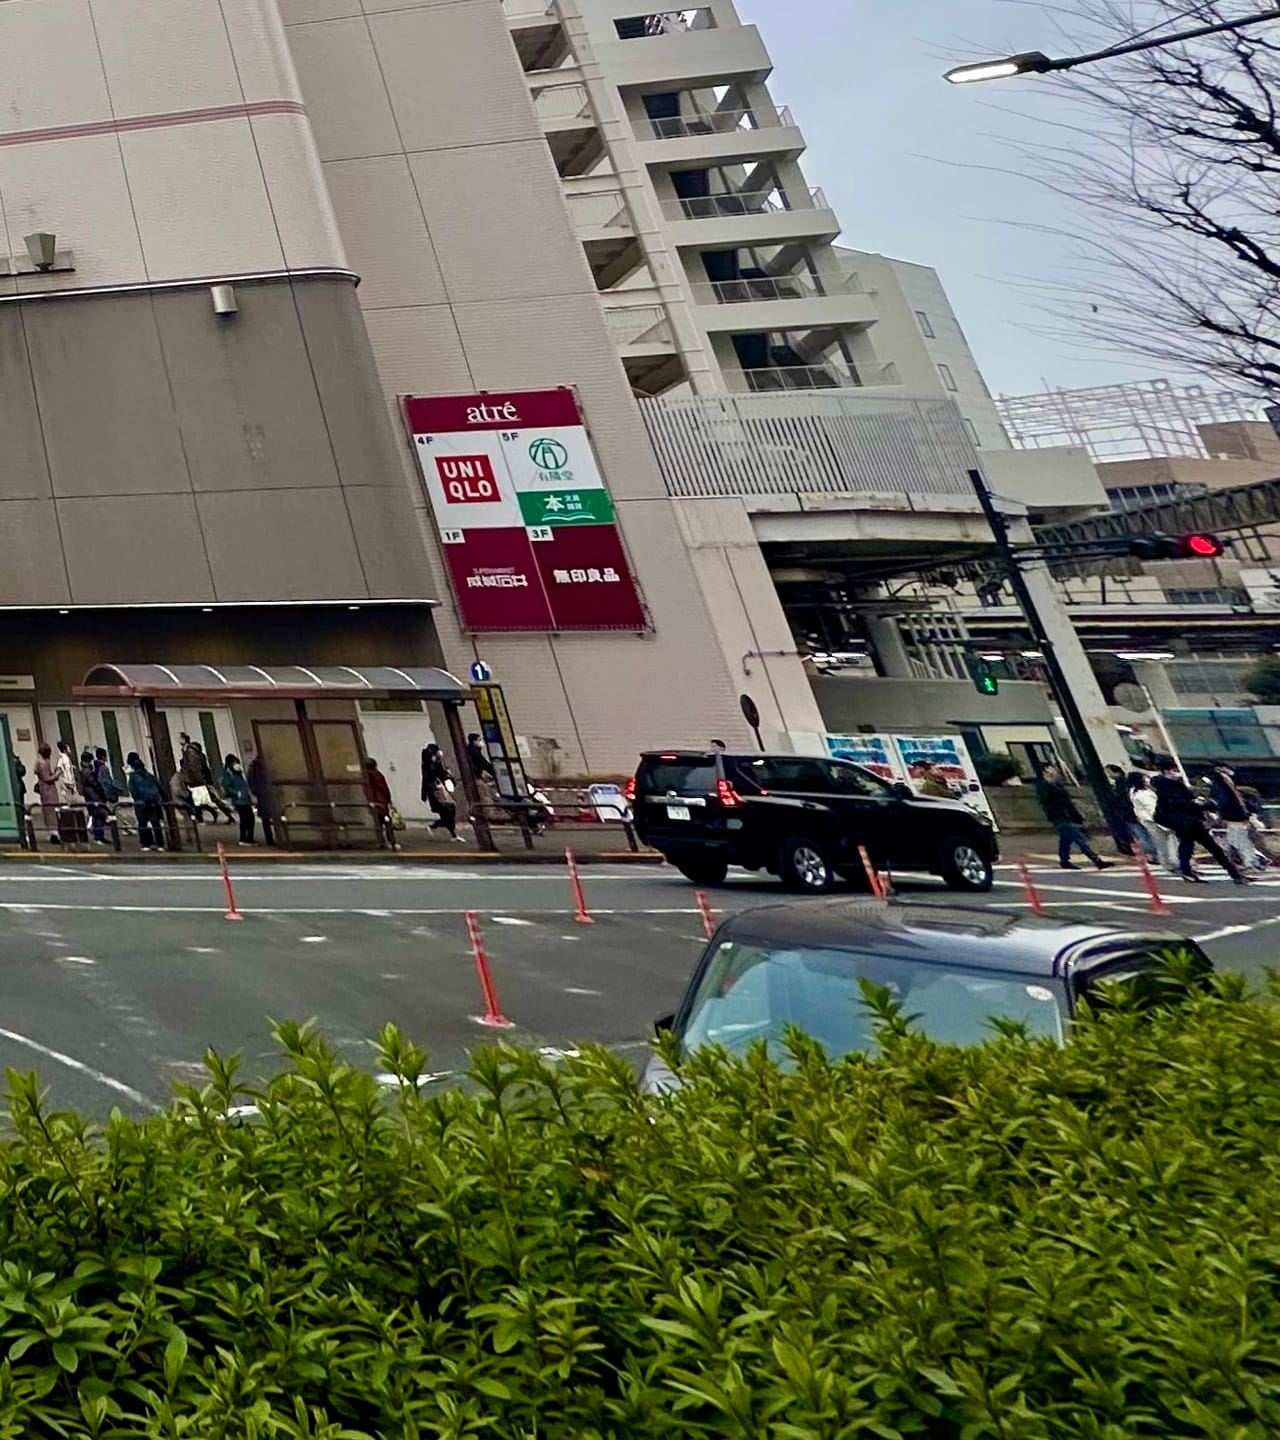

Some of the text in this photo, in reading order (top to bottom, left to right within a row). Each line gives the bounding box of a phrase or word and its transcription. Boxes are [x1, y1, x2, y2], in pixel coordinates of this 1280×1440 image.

[466, 401, 519, 422] atré
[418, 436, 434, 445] 4F
[442, 461, 484, 478] UNI
[449, 480, 492, 500] QLO
[543, 495, 565, 511] 本
[553, 568, 620, 583] 無印良品
